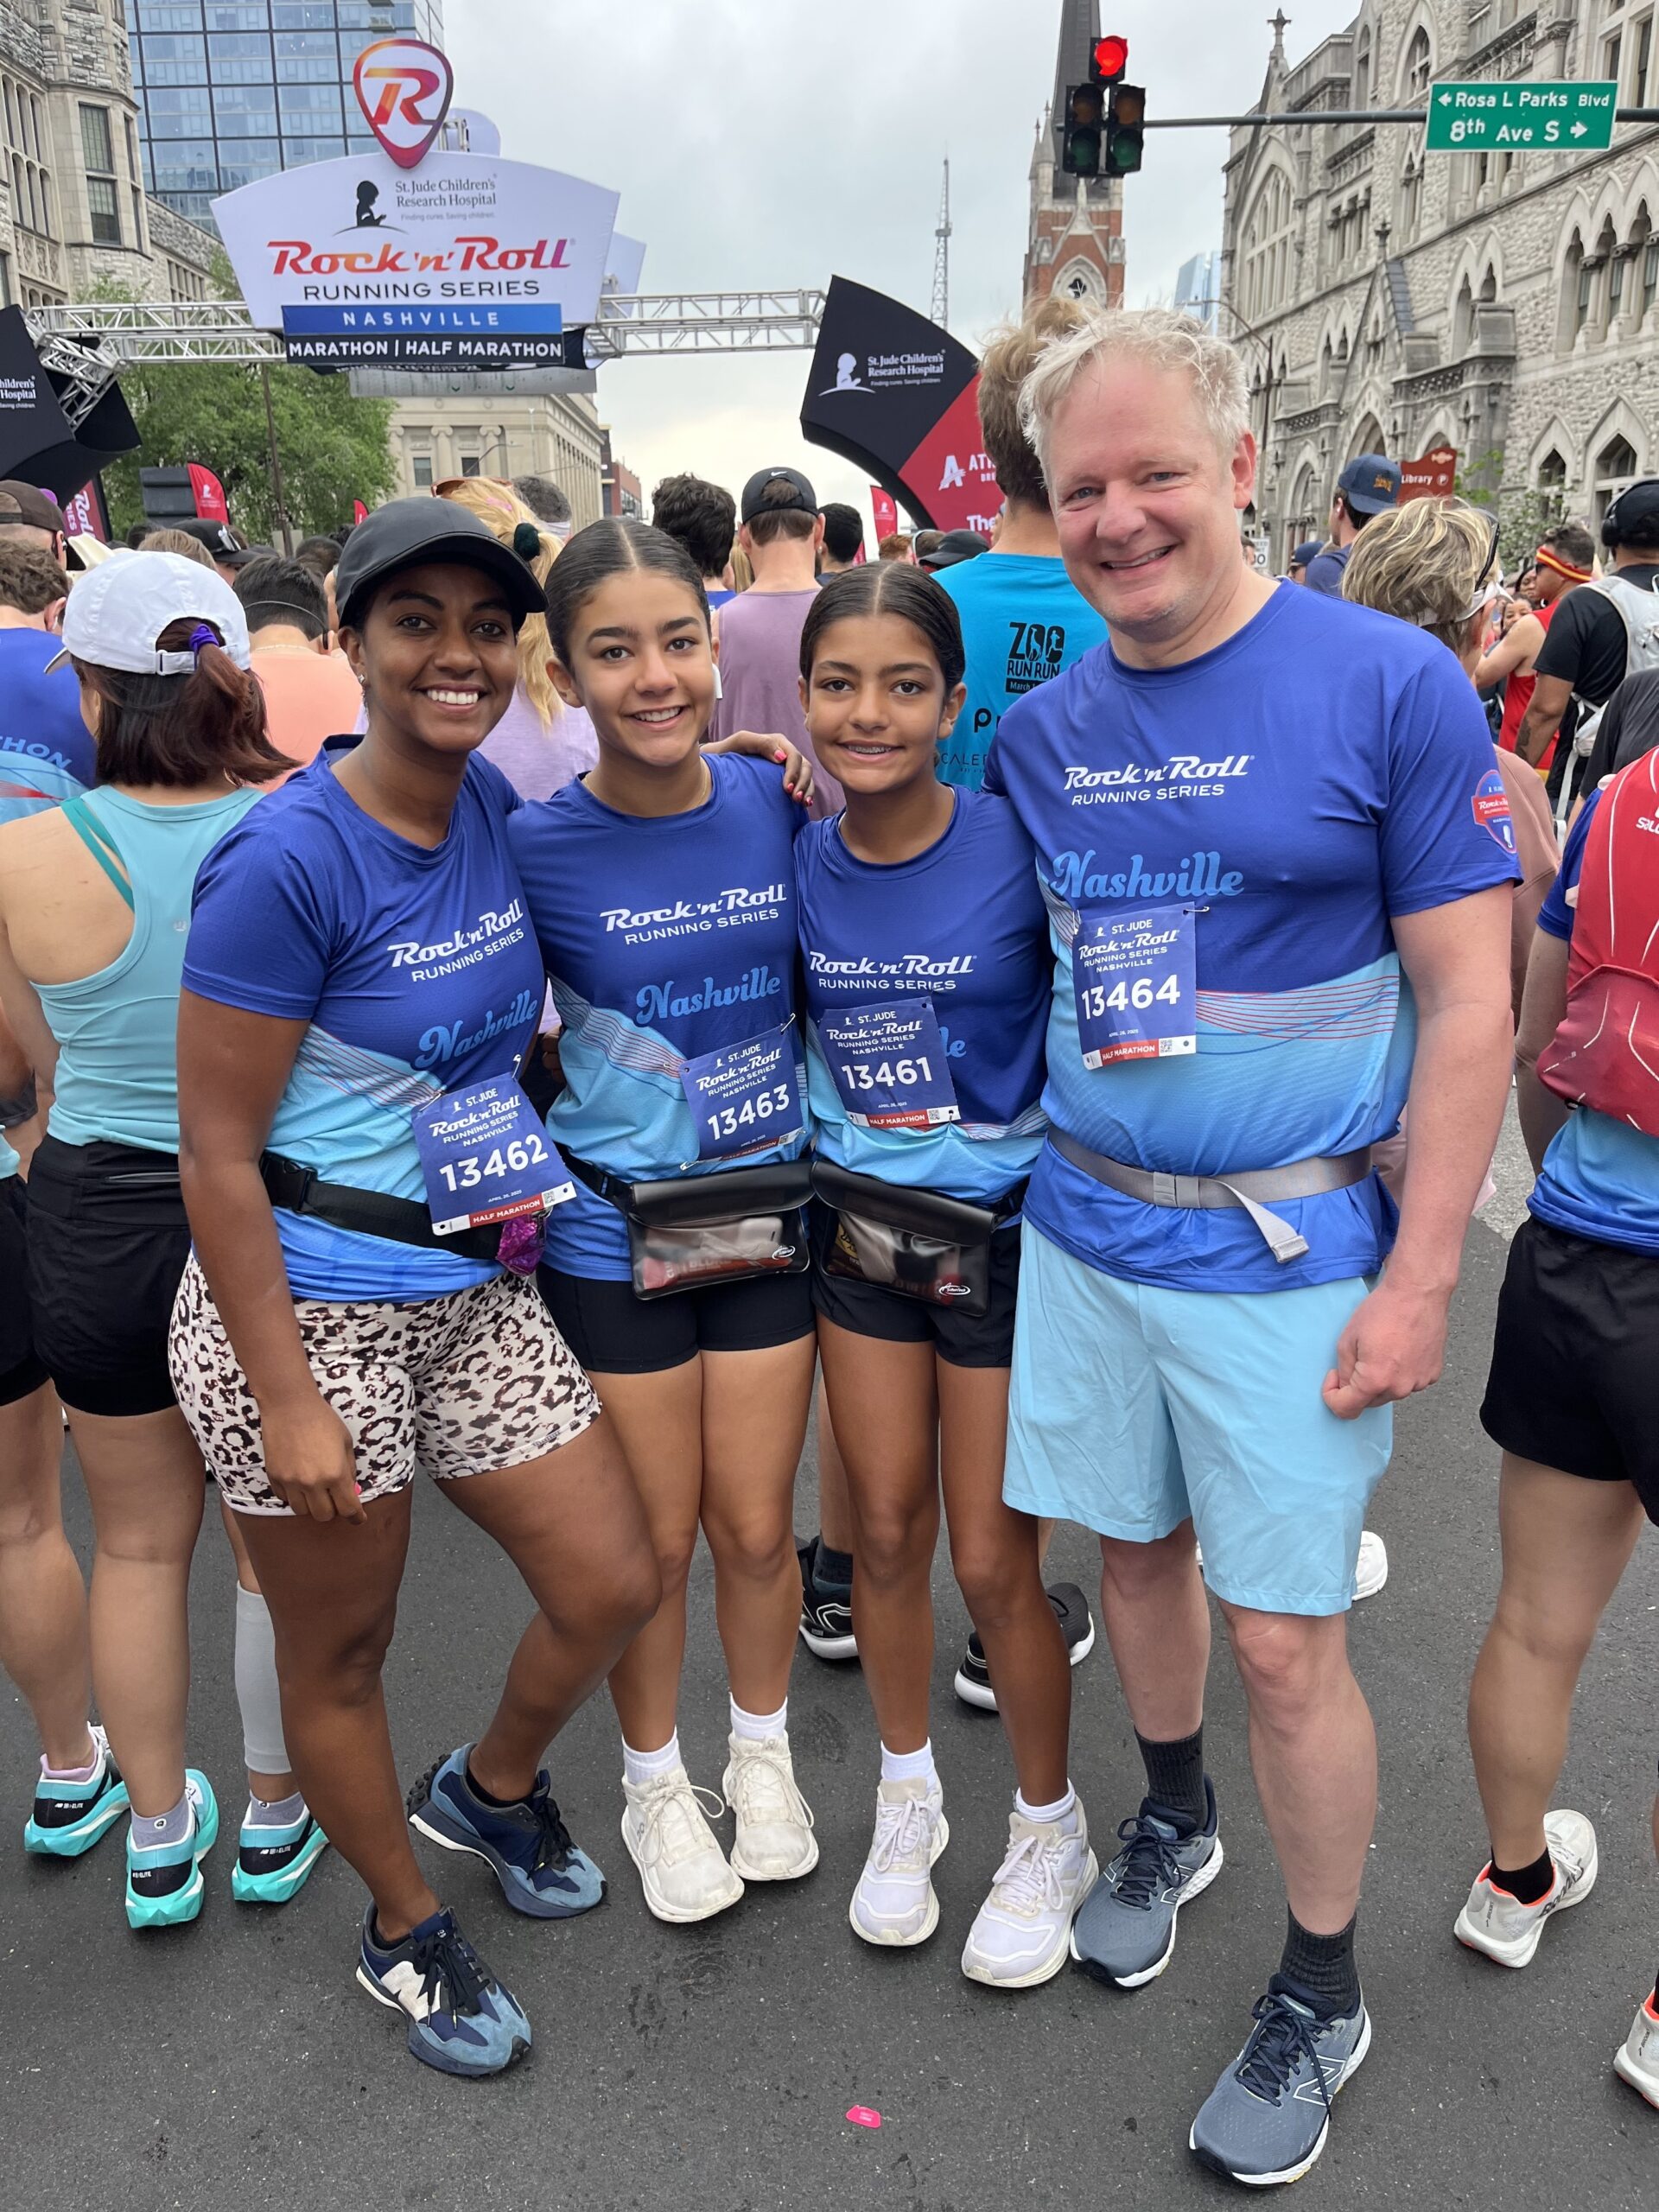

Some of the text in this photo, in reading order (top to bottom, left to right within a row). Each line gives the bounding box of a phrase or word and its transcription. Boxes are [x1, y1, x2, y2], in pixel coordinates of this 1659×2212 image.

[1455, 92, 1610, 107] Rosa L Parks Blvd
[1450, 118, 1560, 142] 8th Ave S
[396, 178, 495, 194] St. Jude Children's
[397, 193, 496, 208] Research Hospital
[304, 281, 539, 301] RUNNING SERIES
[343, 312, 499, 326] NASHVILLE
[289, 340, 562, 357] MARATHON HALF MARATHON
[868, 363, 944, 377] Research Hospital
[880, 354, 899, 367] Jude
[899, 353, 944, 363] Children's
[1402, 474, 1433, 486] Library
[1009, 622, 1065, 664] ZOO
[1007, 659, 1061, 679] RUN RUN
[1071, 784, 1224, 805] RUNNING SERIES
[1050, 849, 1245, 898] Nashville
[624, 908, 779, 945] RUNNING SERIES
[1111, 918, 1153, 935] ST. JUDE
[411, 928, 524, 982] RUNNING SERIES
[1084, 946, 1167, 968] RUNNING SERIES
[1096, 958, 1154, 973] NASHVILLE
[635, 965, 780, 1024] Nashville
[818, 978, 957, 991] RUNNING SERIES
[1081, 974, 1181, 1020] 13464
[858, 1011, 897, 1024] ST. JUDE
[415, 989, 538, 1069] Nashville
[837, 1033, 915, 1048] RUNNING SERIES
[852, 1044, 905, 1055] NASHVILLE
[728, 1044, 761, 1063] ST. JUDE
[1102, 1045, 1155, 1060] HALF MARATHON
[708, 1064, 777, 1096] RUNNING SERIES
[841, 1057, 932, 1090] 13461
[722, 1076, 768, 1098] NASHVILLE
[466, 1088, 499, 1107] ST. JUDE
[707, 1084, 790, 1141] 13463
[886, 1114, 925, 1124] MARATHON
[442, 1110, 518, 1144] RUNNING SERIES
[462, 1122, 513, 1147] NASHVILLE
[439, 1134, 549, 1192] 13462
[474, 1199, 540, 1224] HALF MARATHON
